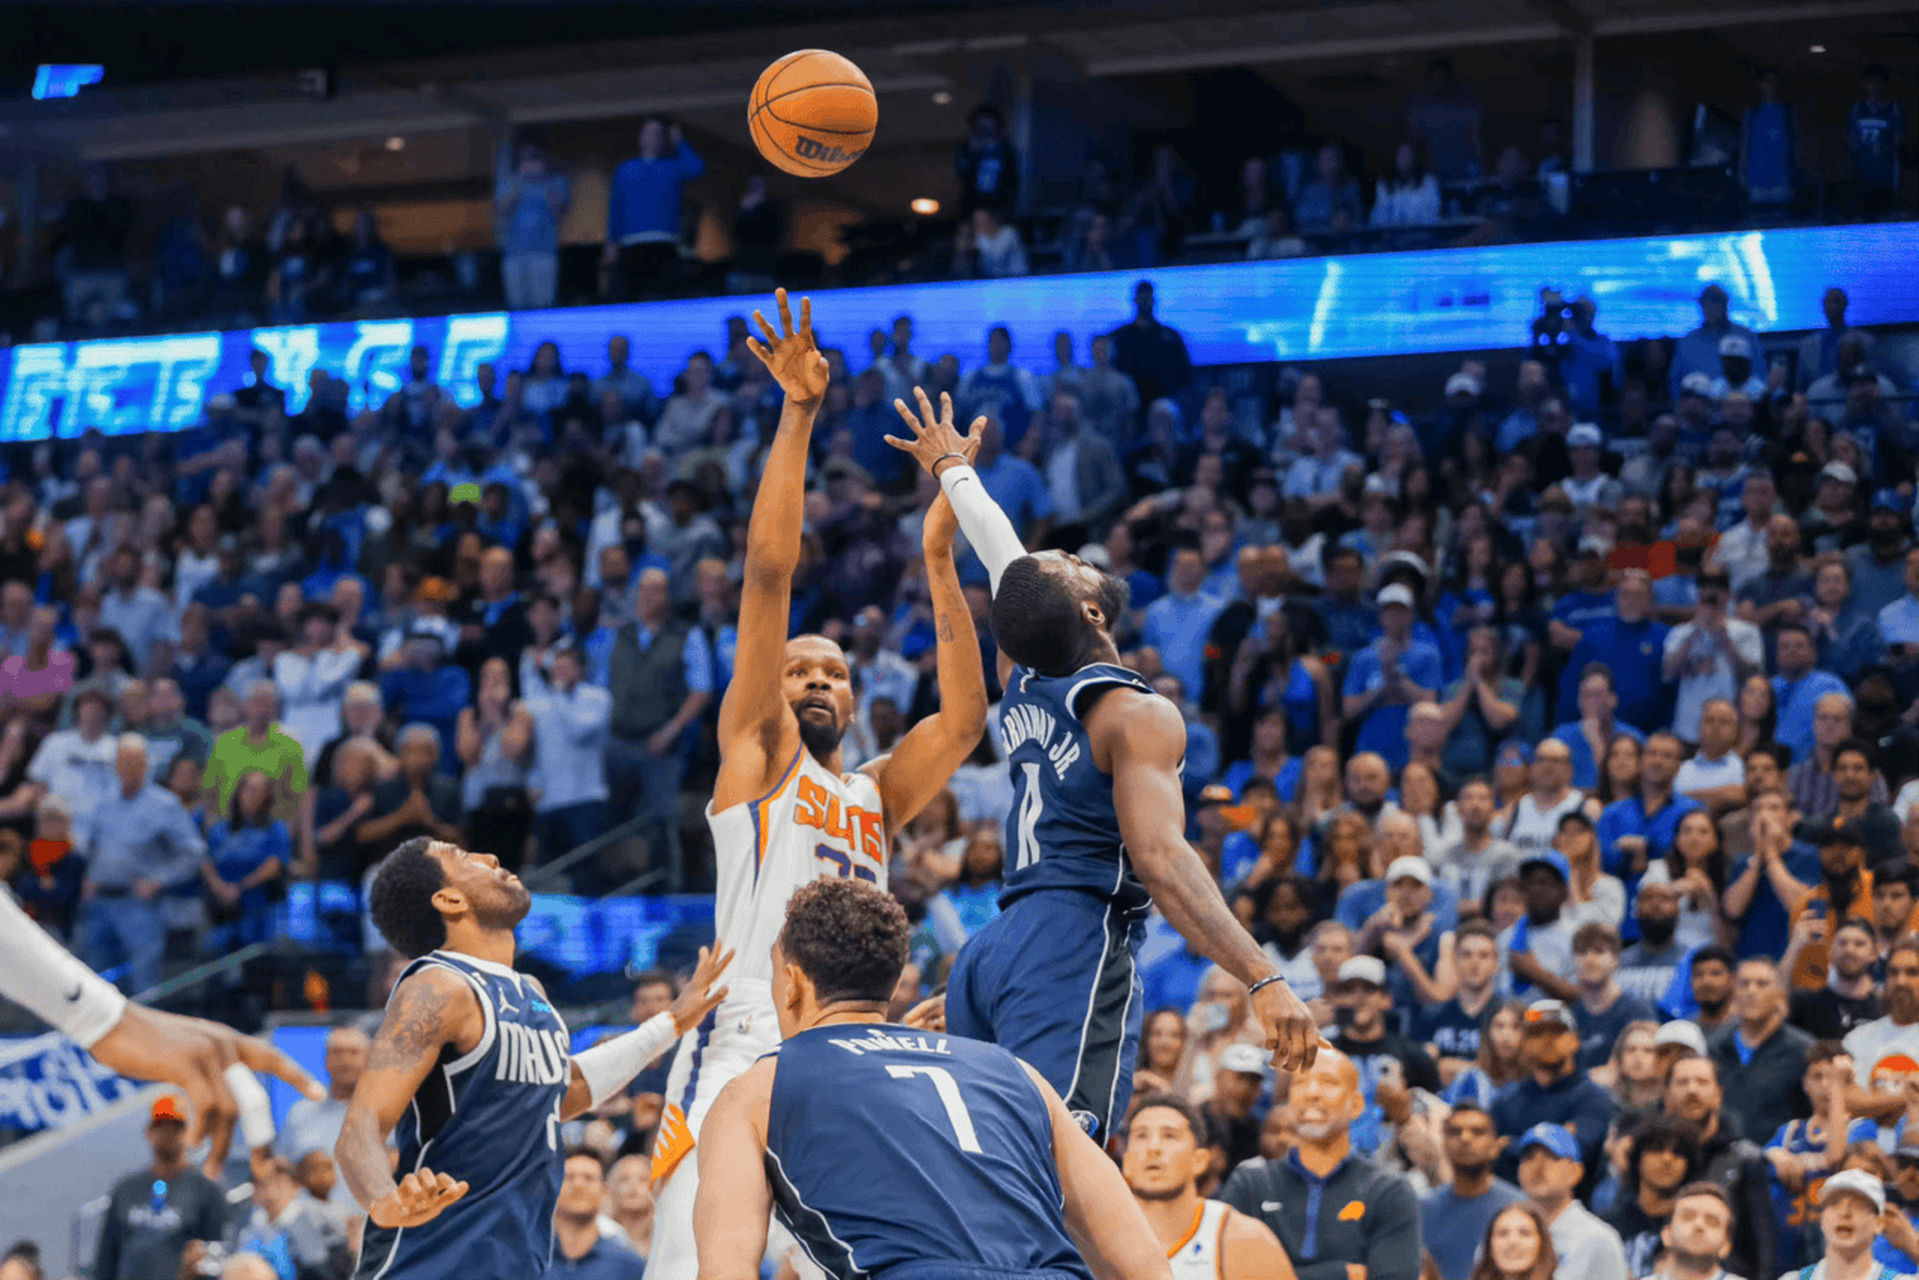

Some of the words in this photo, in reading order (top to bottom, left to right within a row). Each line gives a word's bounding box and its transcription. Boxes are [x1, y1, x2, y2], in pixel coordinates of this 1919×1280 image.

[1048, 731, 1080, 781] JR.
[827, 1036, 952, 1056] POWELL
[884, 1065, 983, 1154] 7
